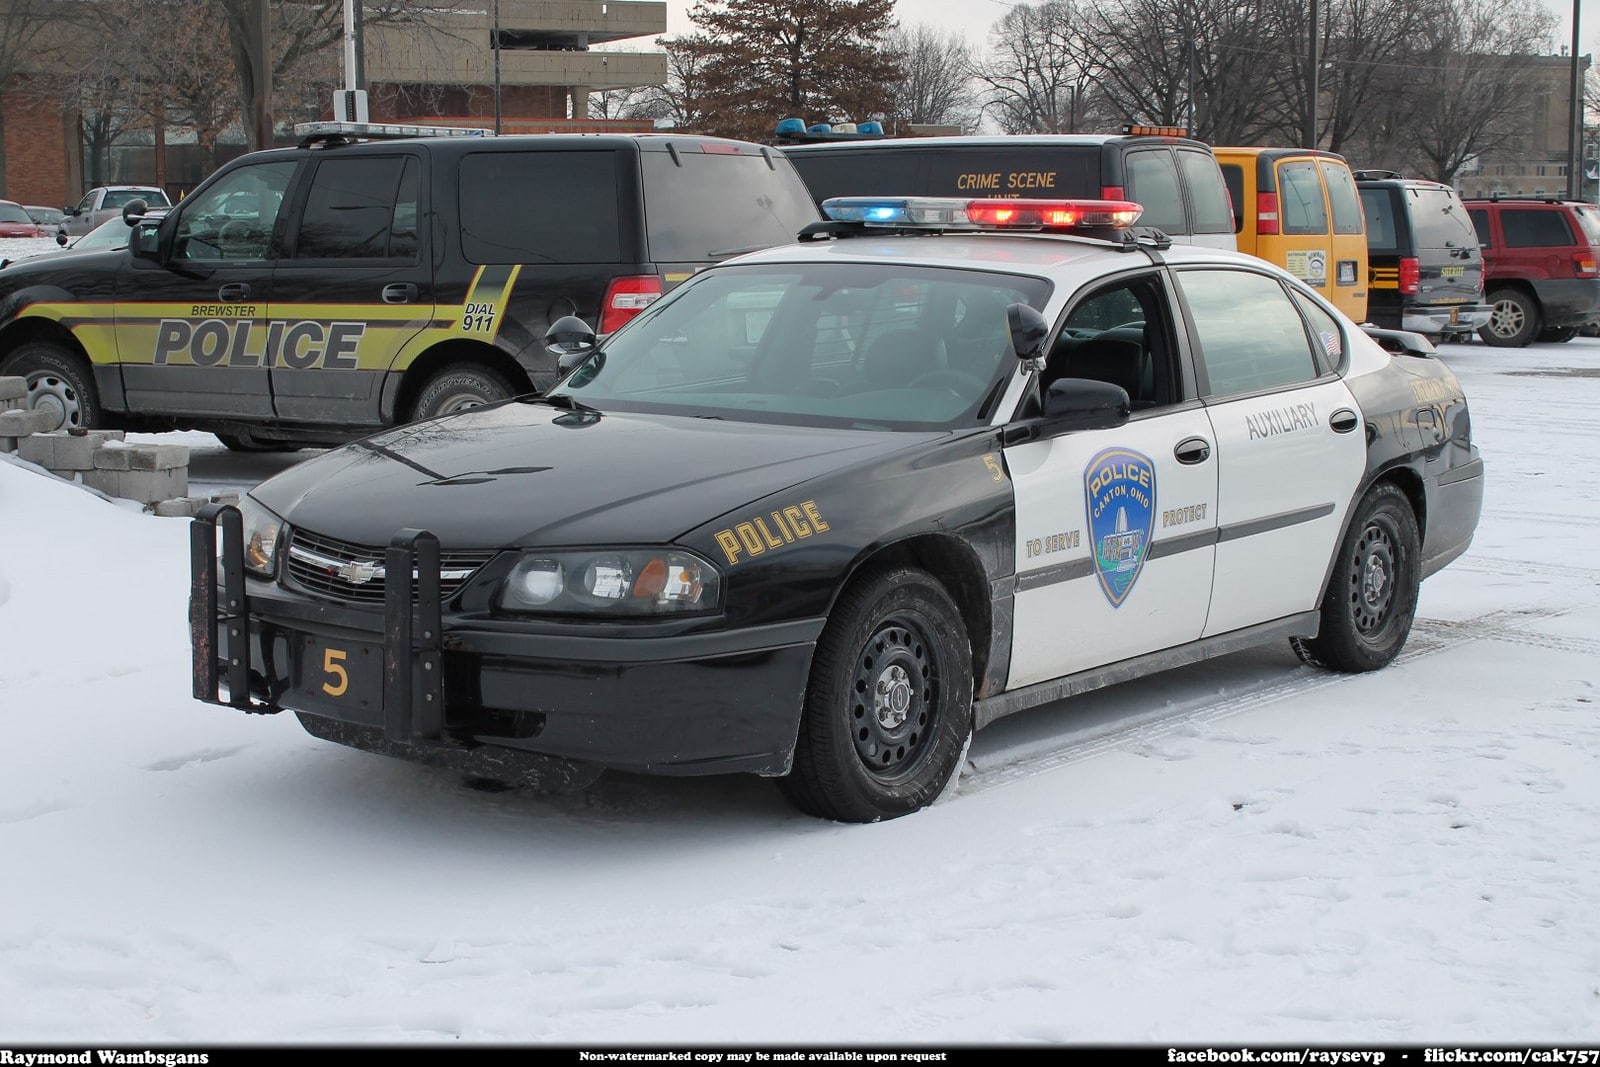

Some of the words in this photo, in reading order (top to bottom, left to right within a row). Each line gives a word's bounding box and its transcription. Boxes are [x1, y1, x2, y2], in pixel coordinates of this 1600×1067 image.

[957, 173, 1001, 189] CRIME
[1007, 172, 1057, 188] SCENE
[191, 304, 256, 316] BREWSTER
[462, 314, 494, 332] 911
[464, 302, 495, 315] DIAL
[152, 319, 367, 371] POLICE
[1245, 402, 1320, 440] AUXILIARY
[983, 452, 1002, 483] 5
[1090, 463, 1150, 498] POLICE
[1094, 485, 1129, 518] CANTON,
[1130, 487, 1149, 509] OHIO
[1162, 503, 1208, 528] PROTECT
[714, 500, 830, 566] POLICE
[1026, 540, 1043, 558] TO
[1045, 529, 1081, 554] SERVE
[322, 648, 350, 697] 5
